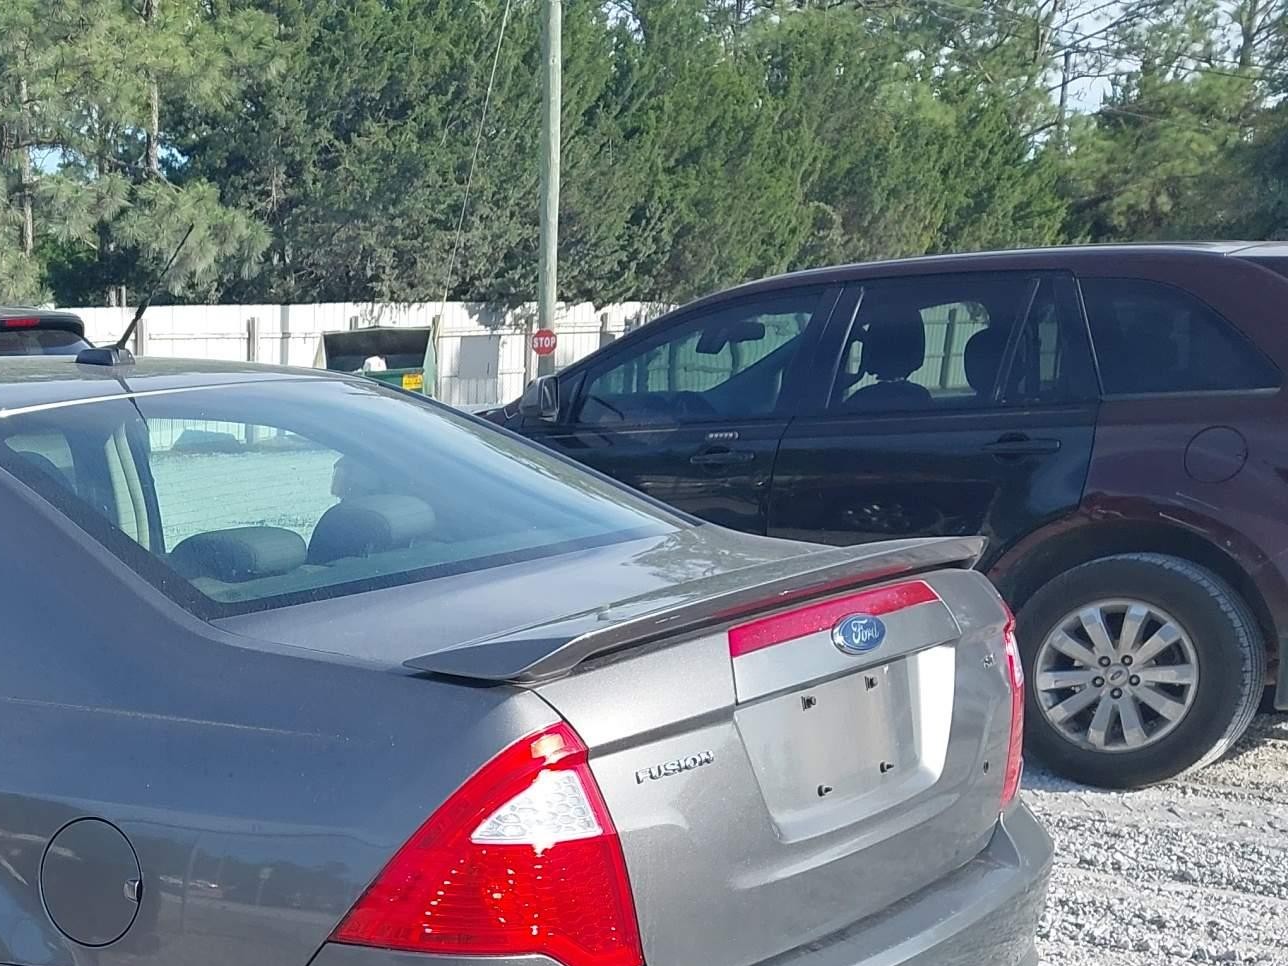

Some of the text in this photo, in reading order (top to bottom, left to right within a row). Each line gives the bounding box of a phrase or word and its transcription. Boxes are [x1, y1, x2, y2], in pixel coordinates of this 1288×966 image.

[533, 336, 556, 348] STOP
[851, 618, 880, 644] Ford
[635, 750, 715, 785] FUSION
